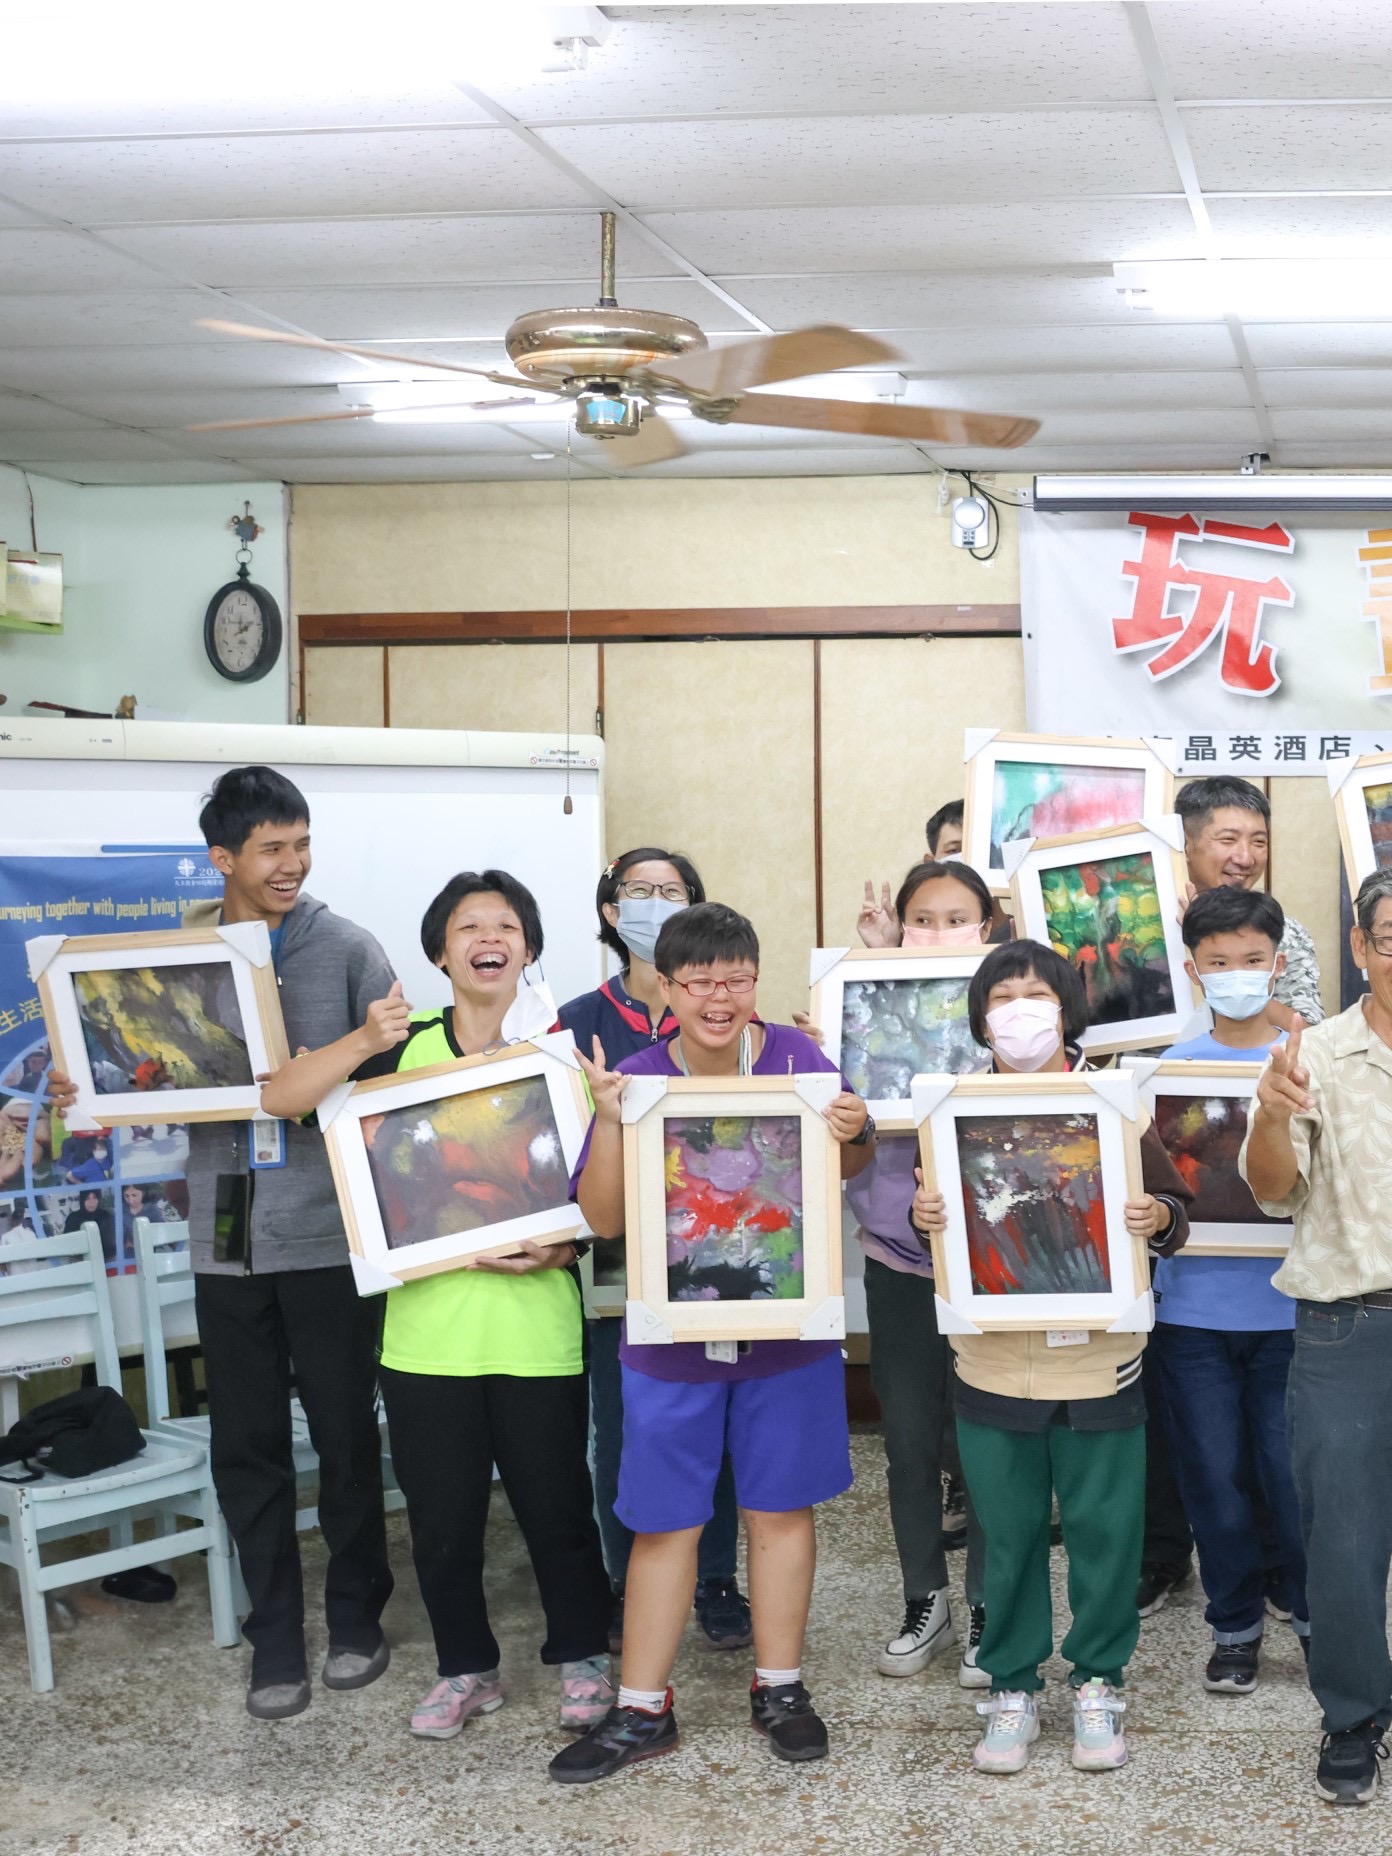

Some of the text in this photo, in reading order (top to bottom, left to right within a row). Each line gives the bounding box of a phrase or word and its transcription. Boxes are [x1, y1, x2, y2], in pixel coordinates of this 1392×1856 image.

[46, 896, 91, 921] together
[93, 897, 115, 916] with
[116, 898, 149, 920] people
[151, 896, 176, 917] living
